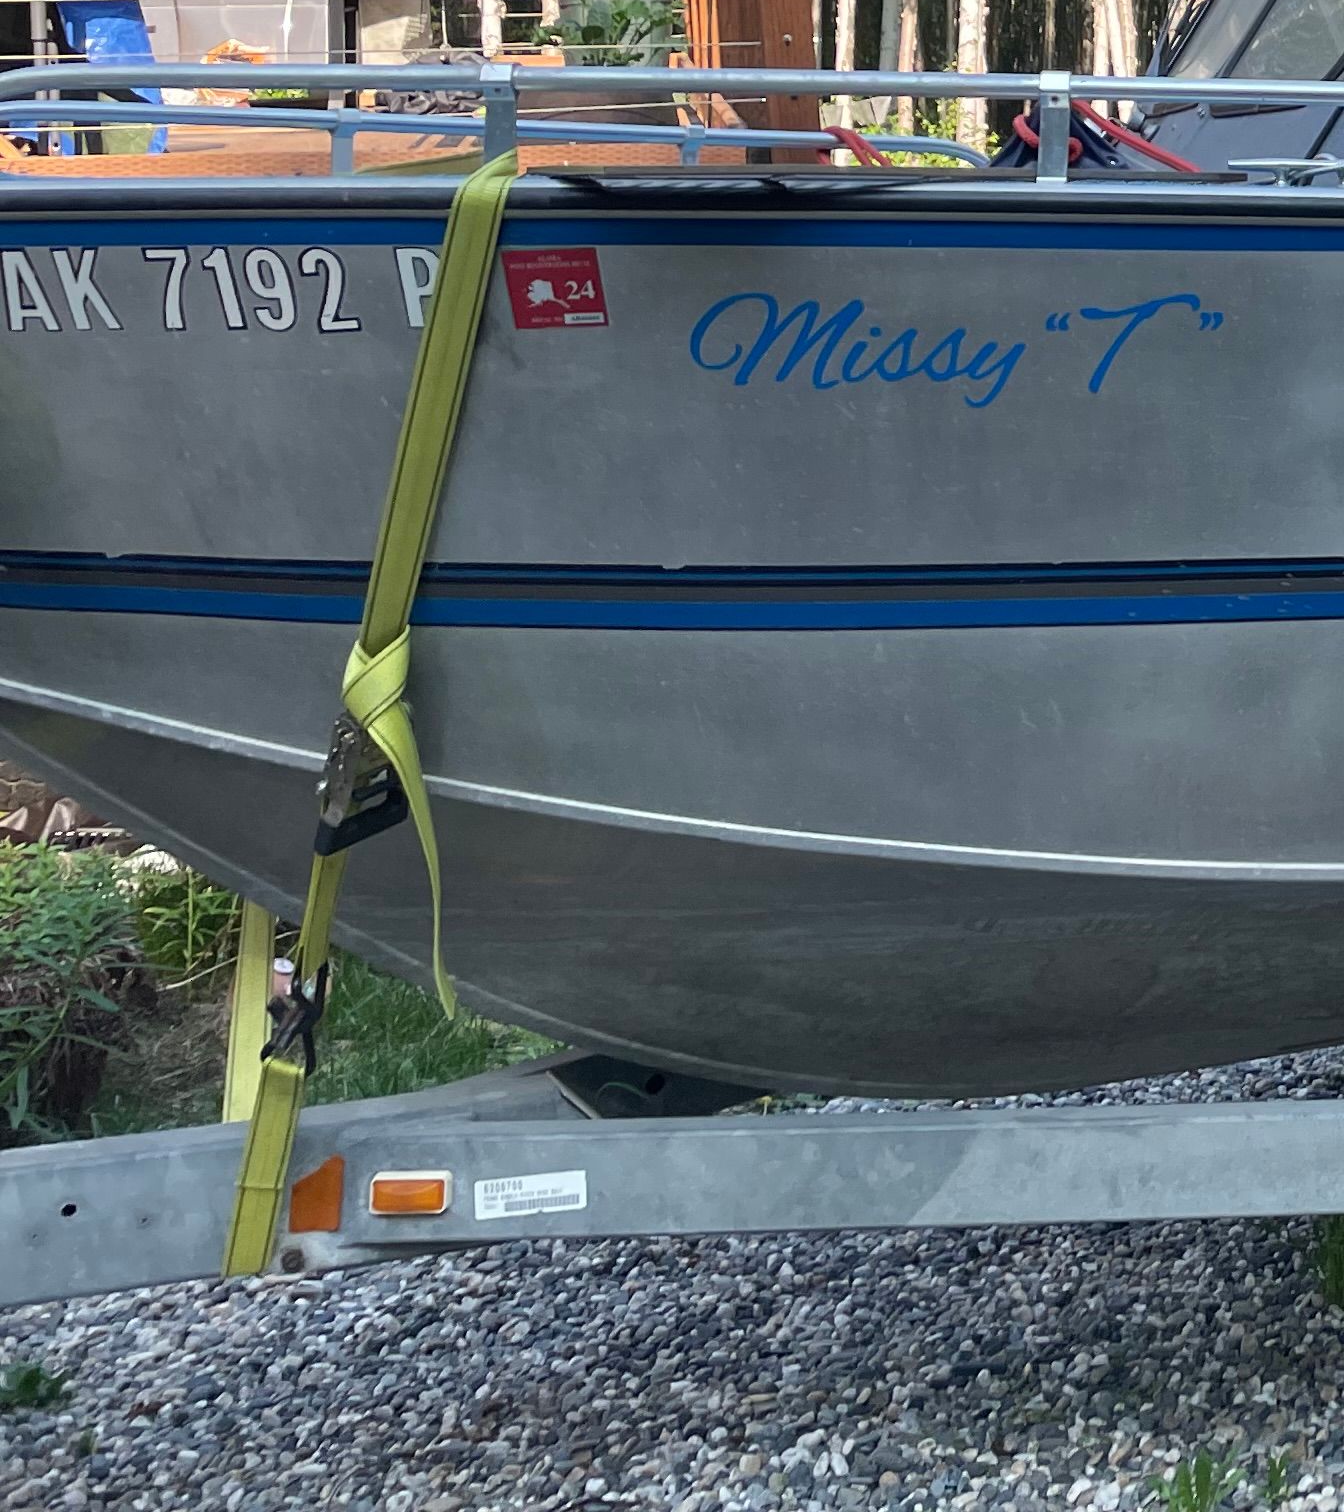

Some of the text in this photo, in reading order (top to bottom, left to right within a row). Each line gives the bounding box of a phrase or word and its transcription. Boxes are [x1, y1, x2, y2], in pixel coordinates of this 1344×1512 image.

[0, 246, 442, 334] AK 7192 P
[565, 280, 595, 300] 24
[690, 292, 1026, 409] Missy
